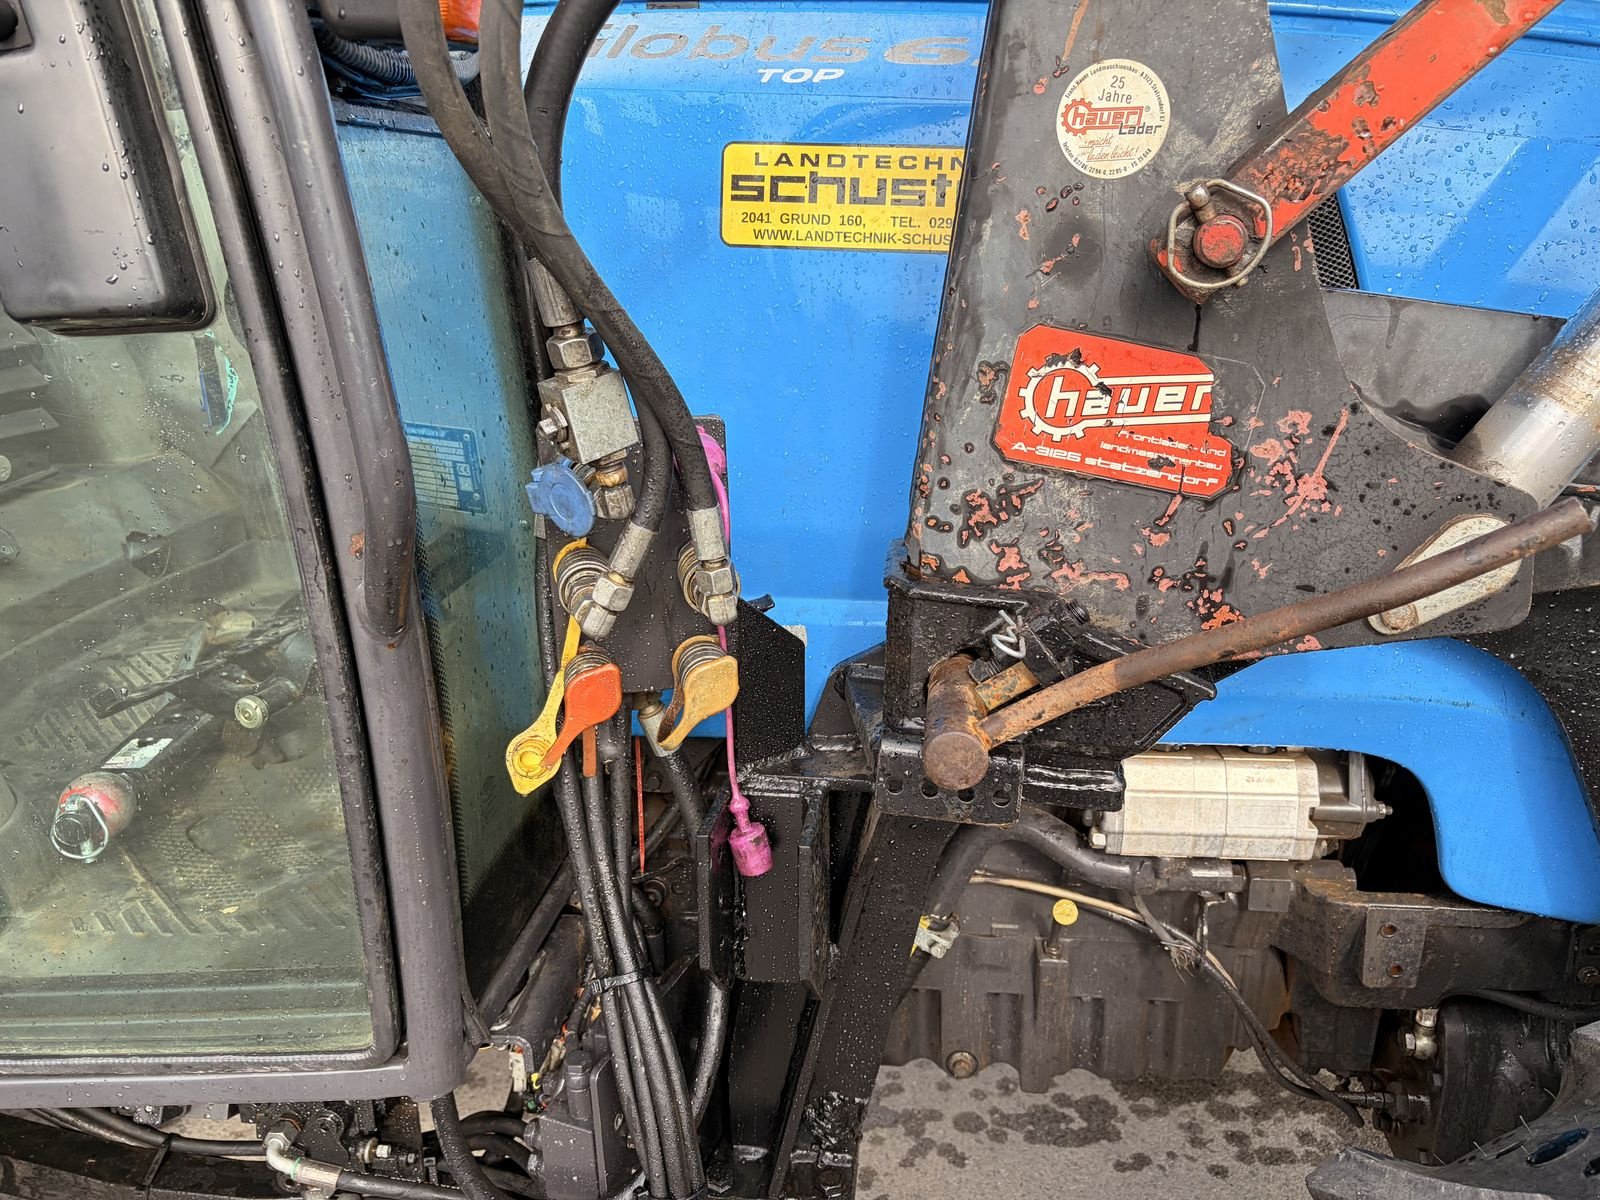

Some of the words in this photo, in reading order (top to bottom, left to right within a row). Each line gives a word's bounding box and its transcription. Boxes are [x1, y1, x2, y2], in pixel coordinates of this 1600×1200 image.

[757, 68, 845, 84] TOP
[1075, 73, 1089, 86] Hauer
[1110, 75, 1126, 90] 25
[1098, 88, 1132, 105] Jahre
[1072, 106, 1138, 126] hauer
[1118, 122, 1162, 135] Lader
[754, 152, 963, 171] LANDTECHN
[741, 212, 771, 224] 2041
[780, 213, 831, 226] GRUND
[839, 214, 866, 228] 160,
[890, 215, 921, 229] TEL.
[1045, 376, 1212, 418] hauer
